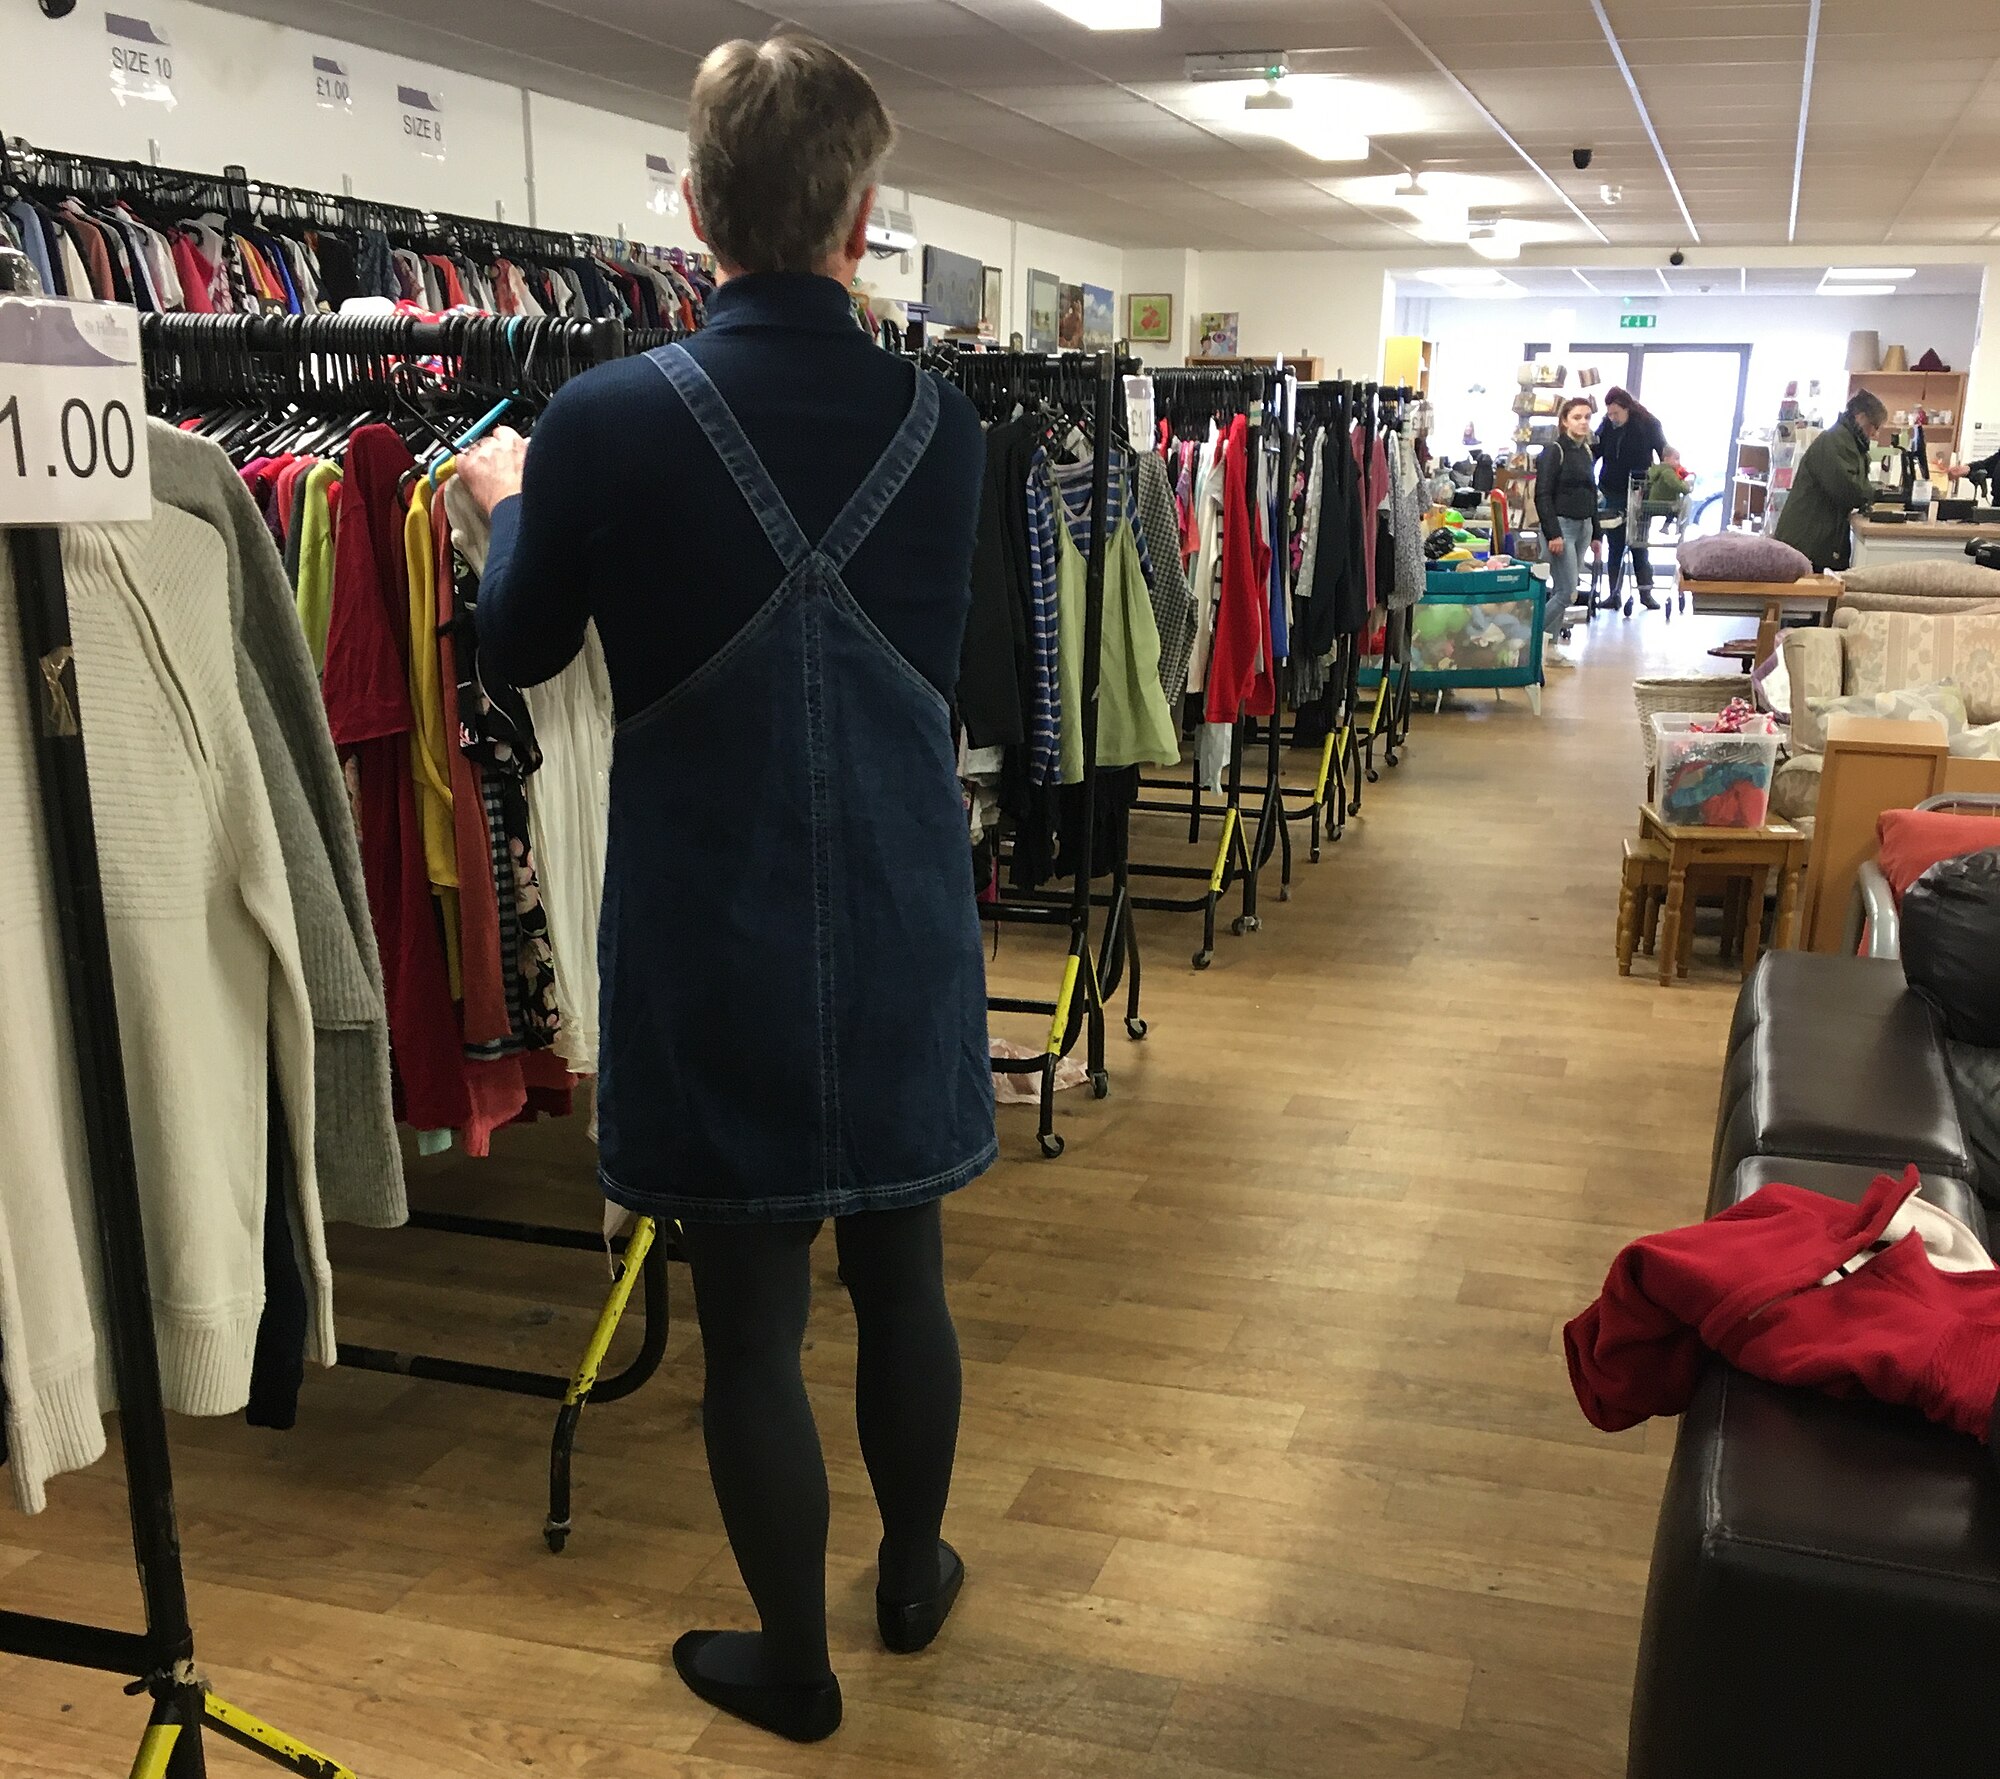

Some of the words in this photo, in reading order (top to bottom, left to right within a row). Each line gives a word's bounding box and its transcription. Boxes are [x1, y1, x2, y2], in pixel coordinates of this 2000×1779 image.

[111, 46, 149, 75] SIZE
[154, 56, 172, 79] 10
[316, 76, 349, 100] £1.00
[403, 114, 432, 139] SIZE
[434, 121, 442, 141] 8
